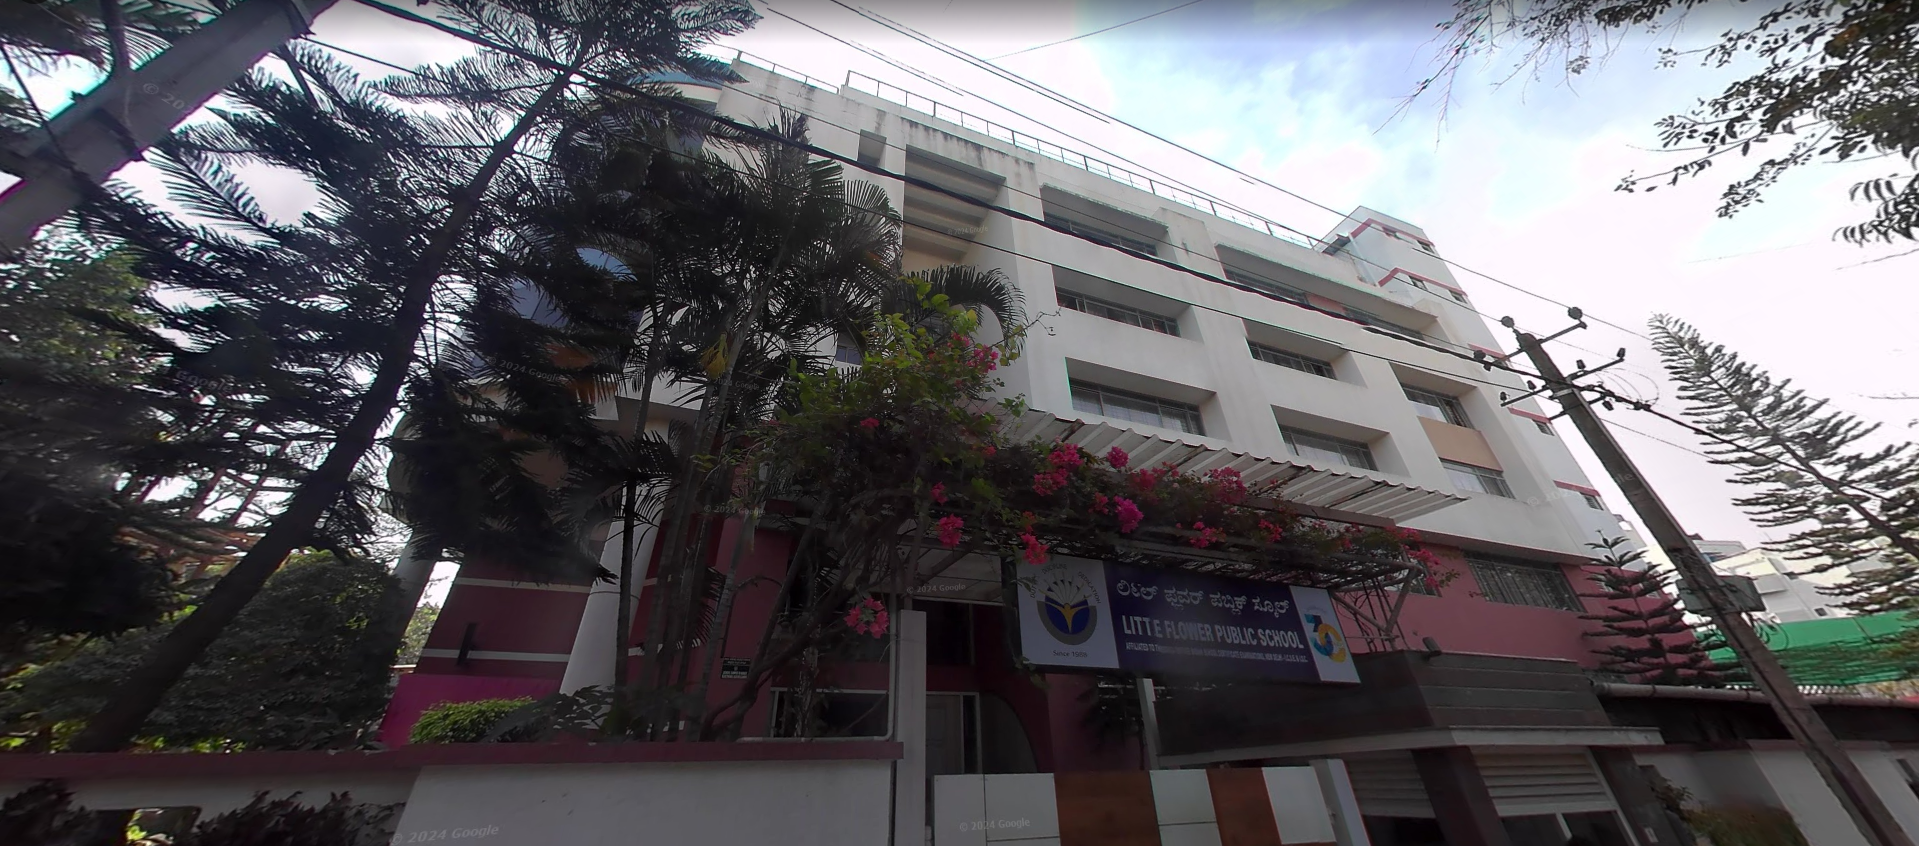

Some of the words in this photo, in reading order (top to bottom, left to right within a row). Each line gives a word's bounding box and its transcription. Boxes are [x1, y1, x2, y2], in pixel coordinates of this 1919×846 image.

[1077, 571, 1102, 604] DEDICATION
[1121, 614, 1163, 638] LITTE
[1164, 620, 1215, 642] FLOWER
[1214, 624, 1258, 646] PUBLIC
[1257, 628, 1305, 649] SCHOOL
[1052, 649, 1070, 657] Since
